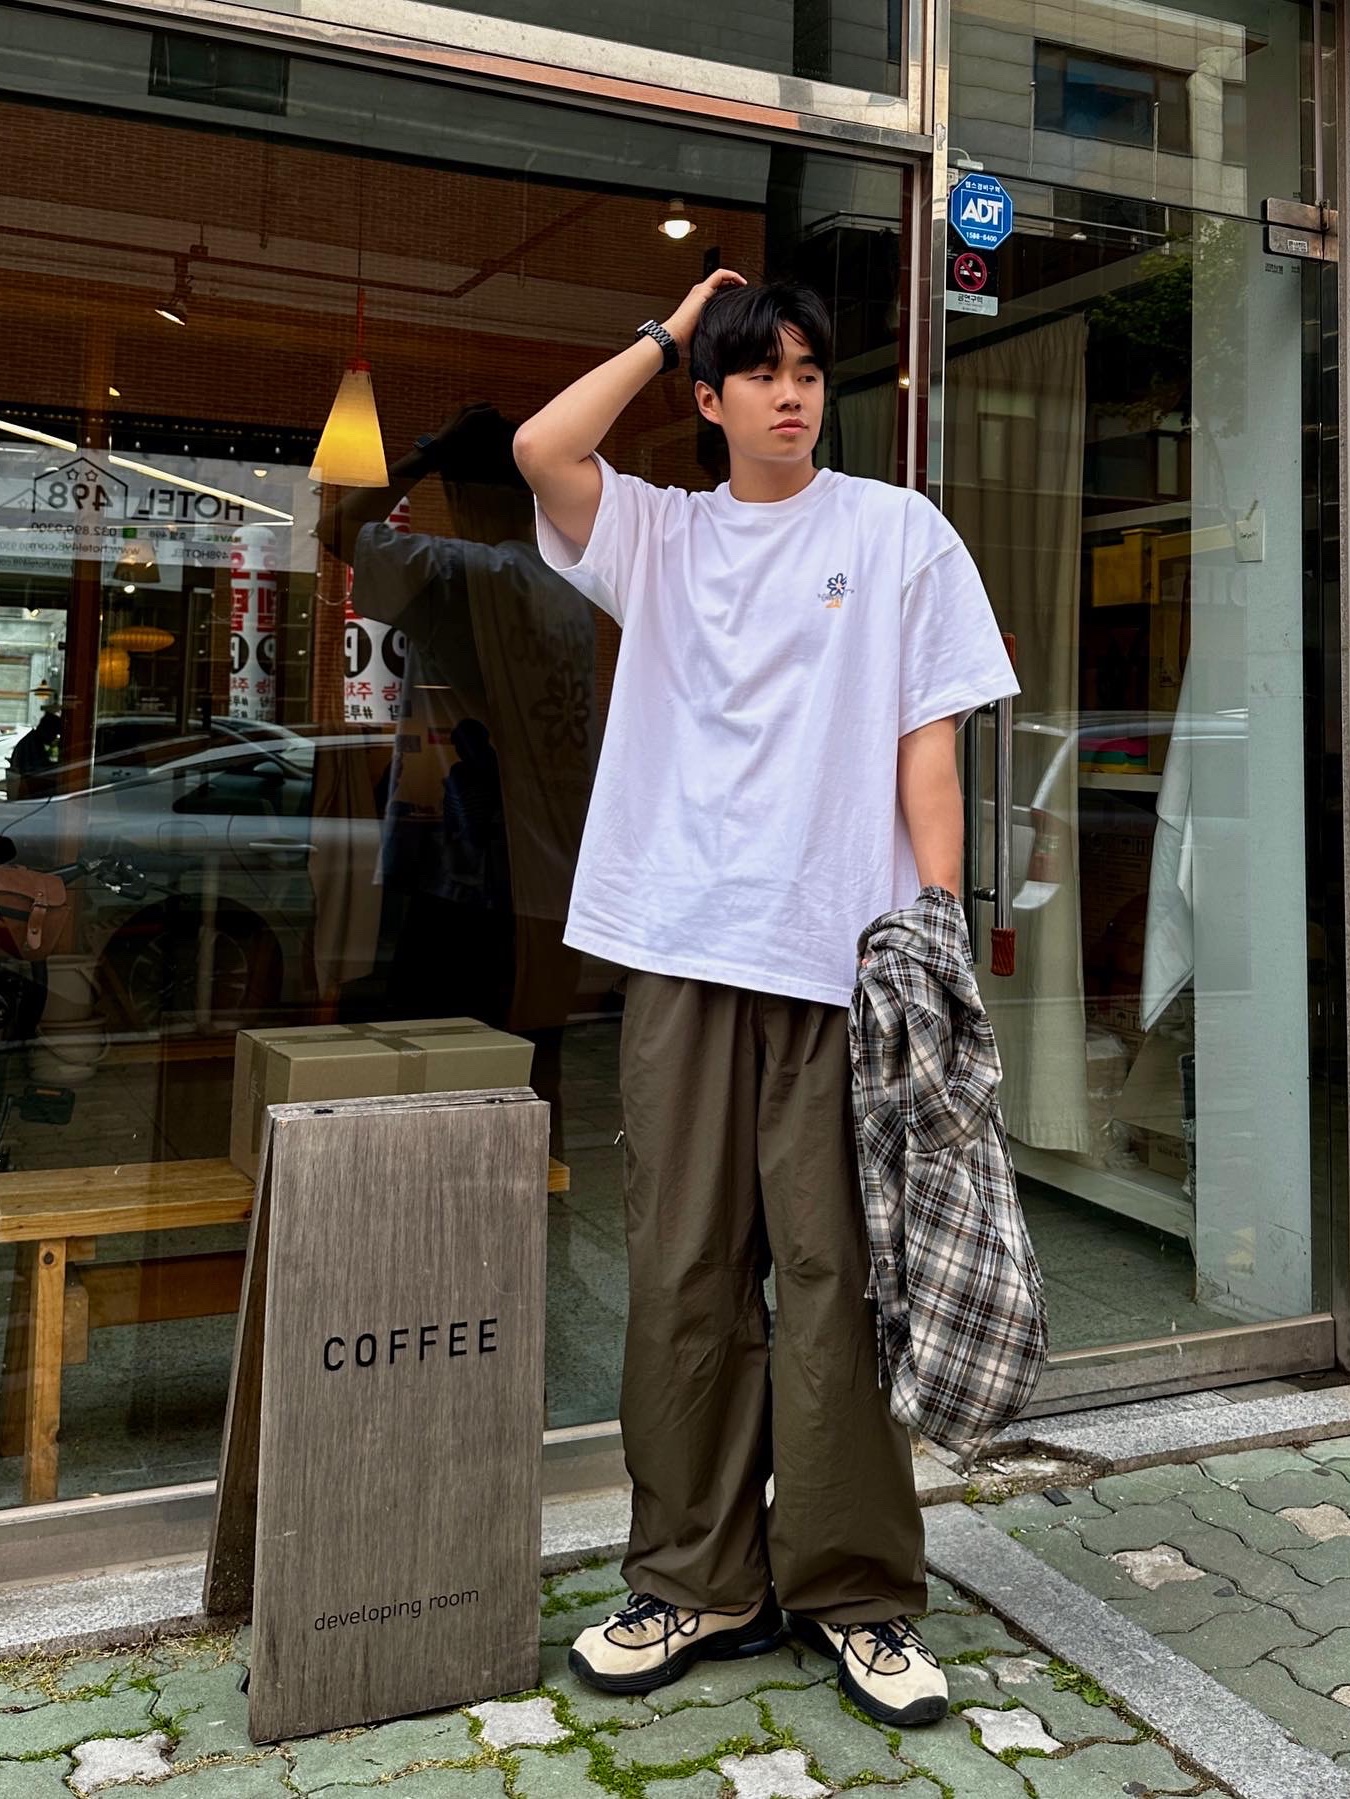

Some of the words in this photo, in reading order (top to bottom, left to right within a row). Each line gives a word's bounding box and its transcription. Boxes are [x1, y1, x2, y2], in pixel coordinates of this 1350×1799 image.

[961, 197, 1003, 226] ADT
[966, 232, 998, 243] 1588-6400
[957, 293, 984, 305] 금연구역
[323, 1318, 498, 1372] COFFEE
[314, 1600, 422, 1631] developing
[429, 1590, 479, 1611] room
